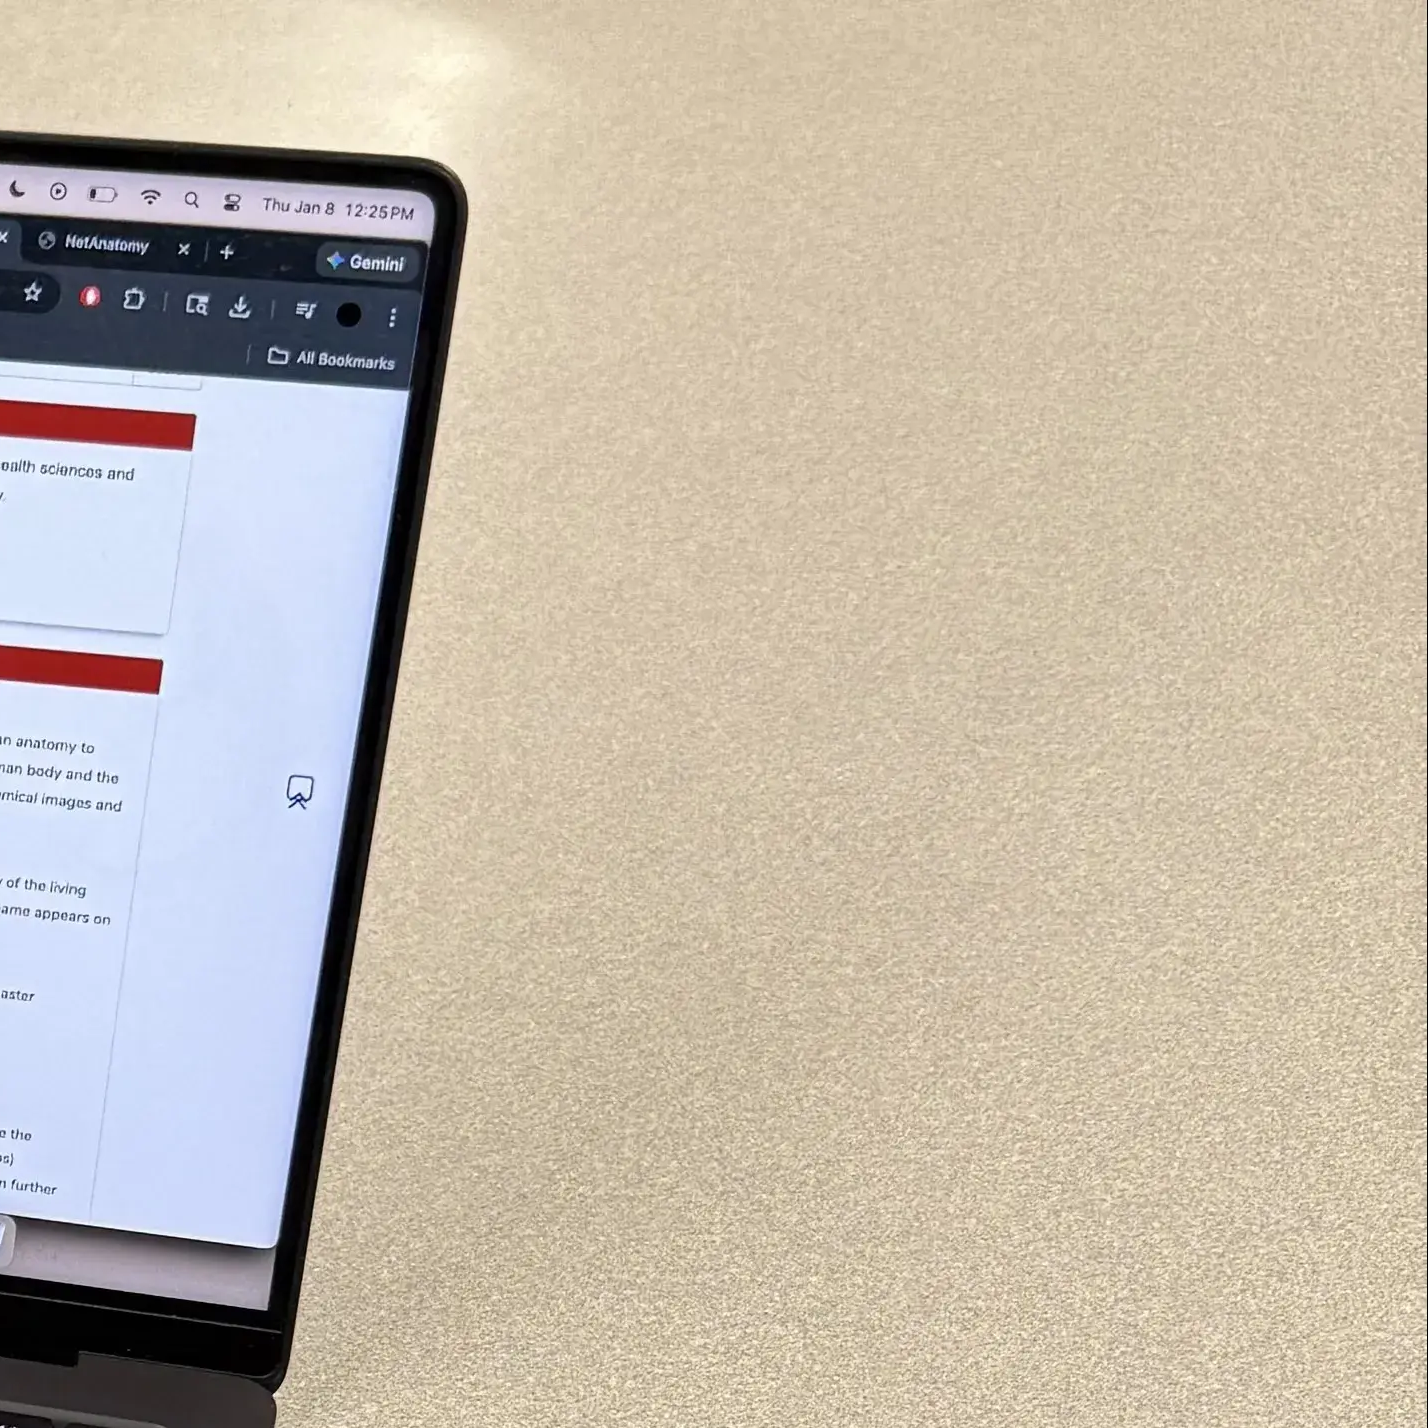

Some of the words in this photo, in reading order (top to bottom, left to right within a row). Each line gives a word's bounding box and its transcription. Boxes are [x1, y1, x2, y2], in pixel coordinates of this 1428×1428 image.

[262, 197, 290, 212] Thu
[294, 200, 321, 214] Jan
[324, 201, 335, 215] 8
[350, 254, 404, 271] Gemini
[296, 350, 315, 364] All
[318, 352, 395, 370] Bookmarks
